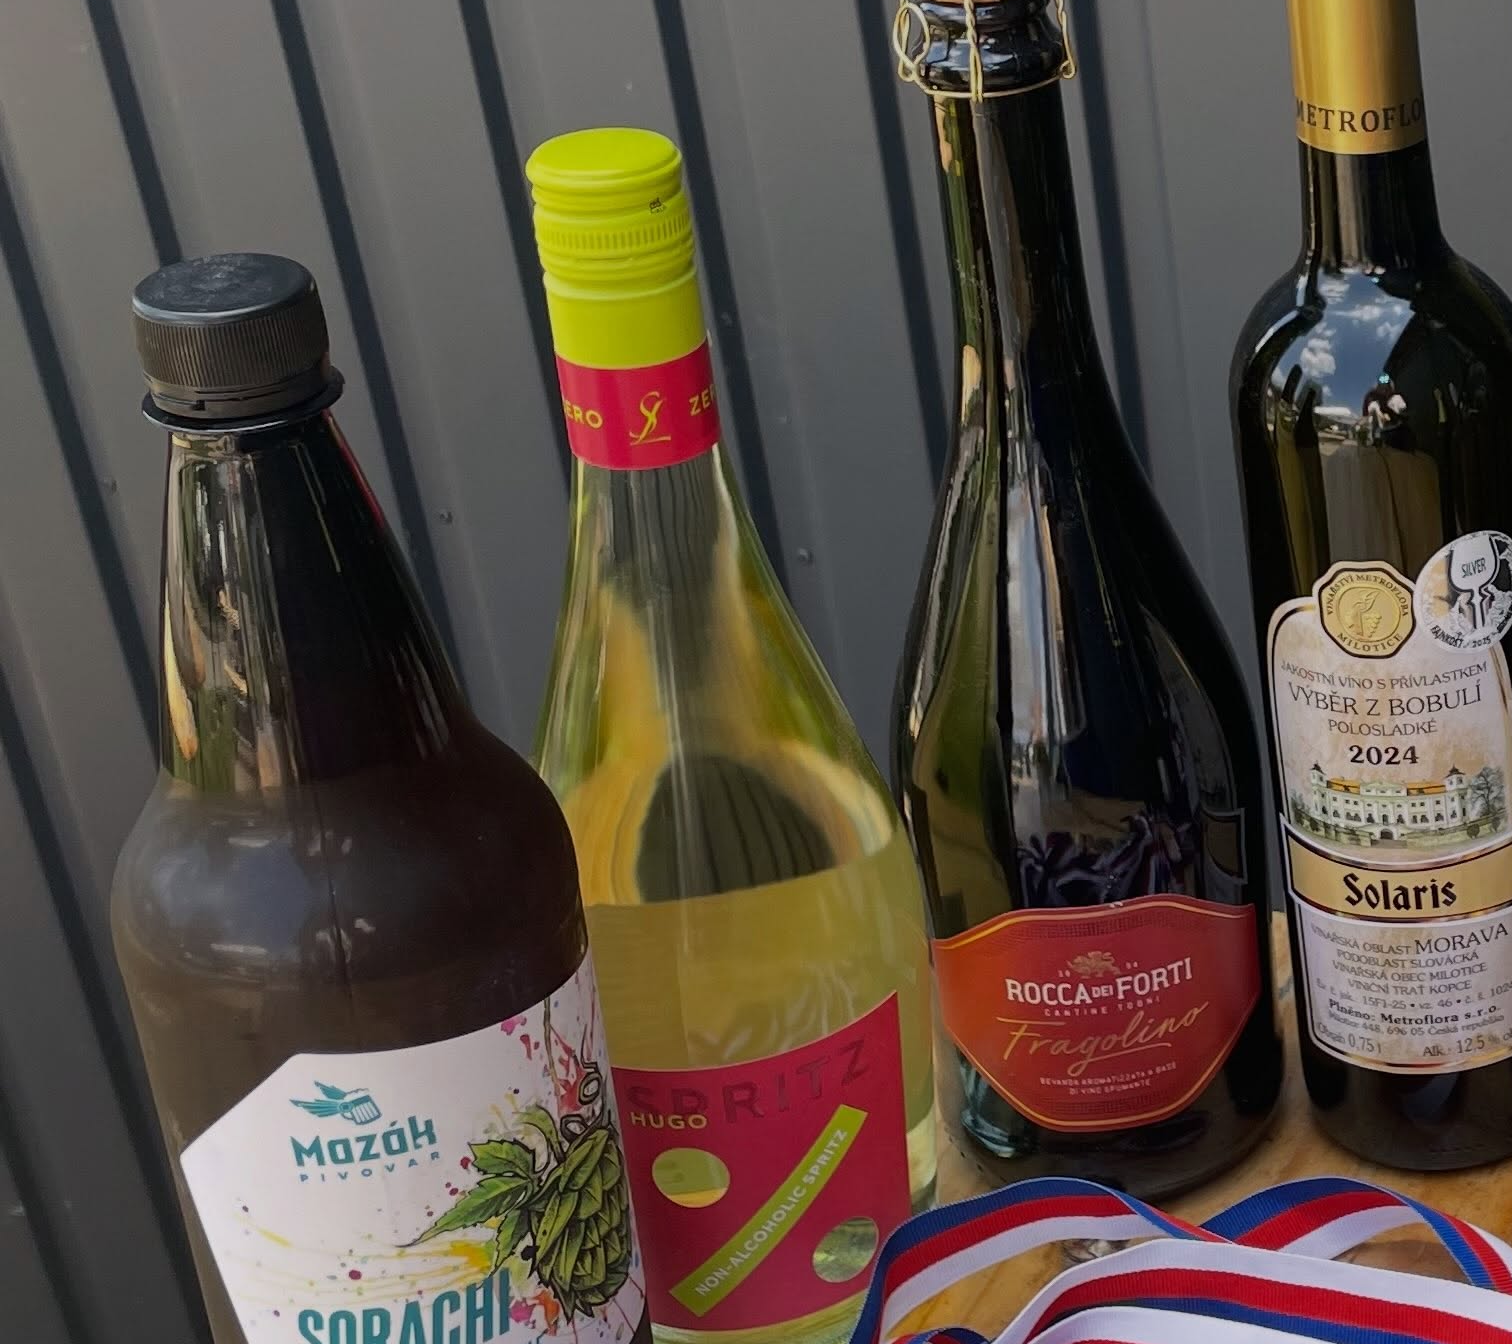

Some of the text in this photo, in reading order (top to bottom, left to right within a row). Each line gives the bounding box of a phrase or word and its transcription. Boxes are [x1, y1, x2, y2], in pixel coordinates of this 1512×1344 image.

[1461, 557, 1487, 579] SILVER
[1356, 574, 1409, 617] METROFLORA
[1338, 632, 1403, 652] MILOTICE
[1376, 679, 1386, 690] S
[1391, 661, 1488, 690] PŘÍVLASTKEM
[1288, 679, 1482, 717] VÝBĚR Z BOBULÍ
[1328, 718, 1439, 737] POLOSLADKÉ
[1349, 744, 1419, 766] 2024
[1343, 872, 1457, 910] Solaris
[1363, 942, 1411, 955] OBLAST
[1414, 922, 1508, 955] MORAVA
[1391, 972, 1426, 982] OBEC
[1429, 962, 1487, 981] MILOTICE
[1410, 949, 1479, 969] SLOVÁCKÁ
[1004, 977, 1093, 1006] ROCCA
[1115, 957, 1193, 1000] FORTI
[1429, 980, 1472, 994] KOPCE
[1380, 1013, 1459, 1026] Metroflora
[1464, 1004, 1501, 1020] s.r.o.
[996, 1001, 1209, 1078] Fragolino
[626, 1038, 870, 1124] SPRITZ
[629, 1111, 708, 1130] HUGO
[290, 1115, 438, 1168] Mazák
[299, 1151, 440, 1183] PIVOVAR
[695, 1128, 848, 1296] NON-ALCOHOLIC SPRITZ
